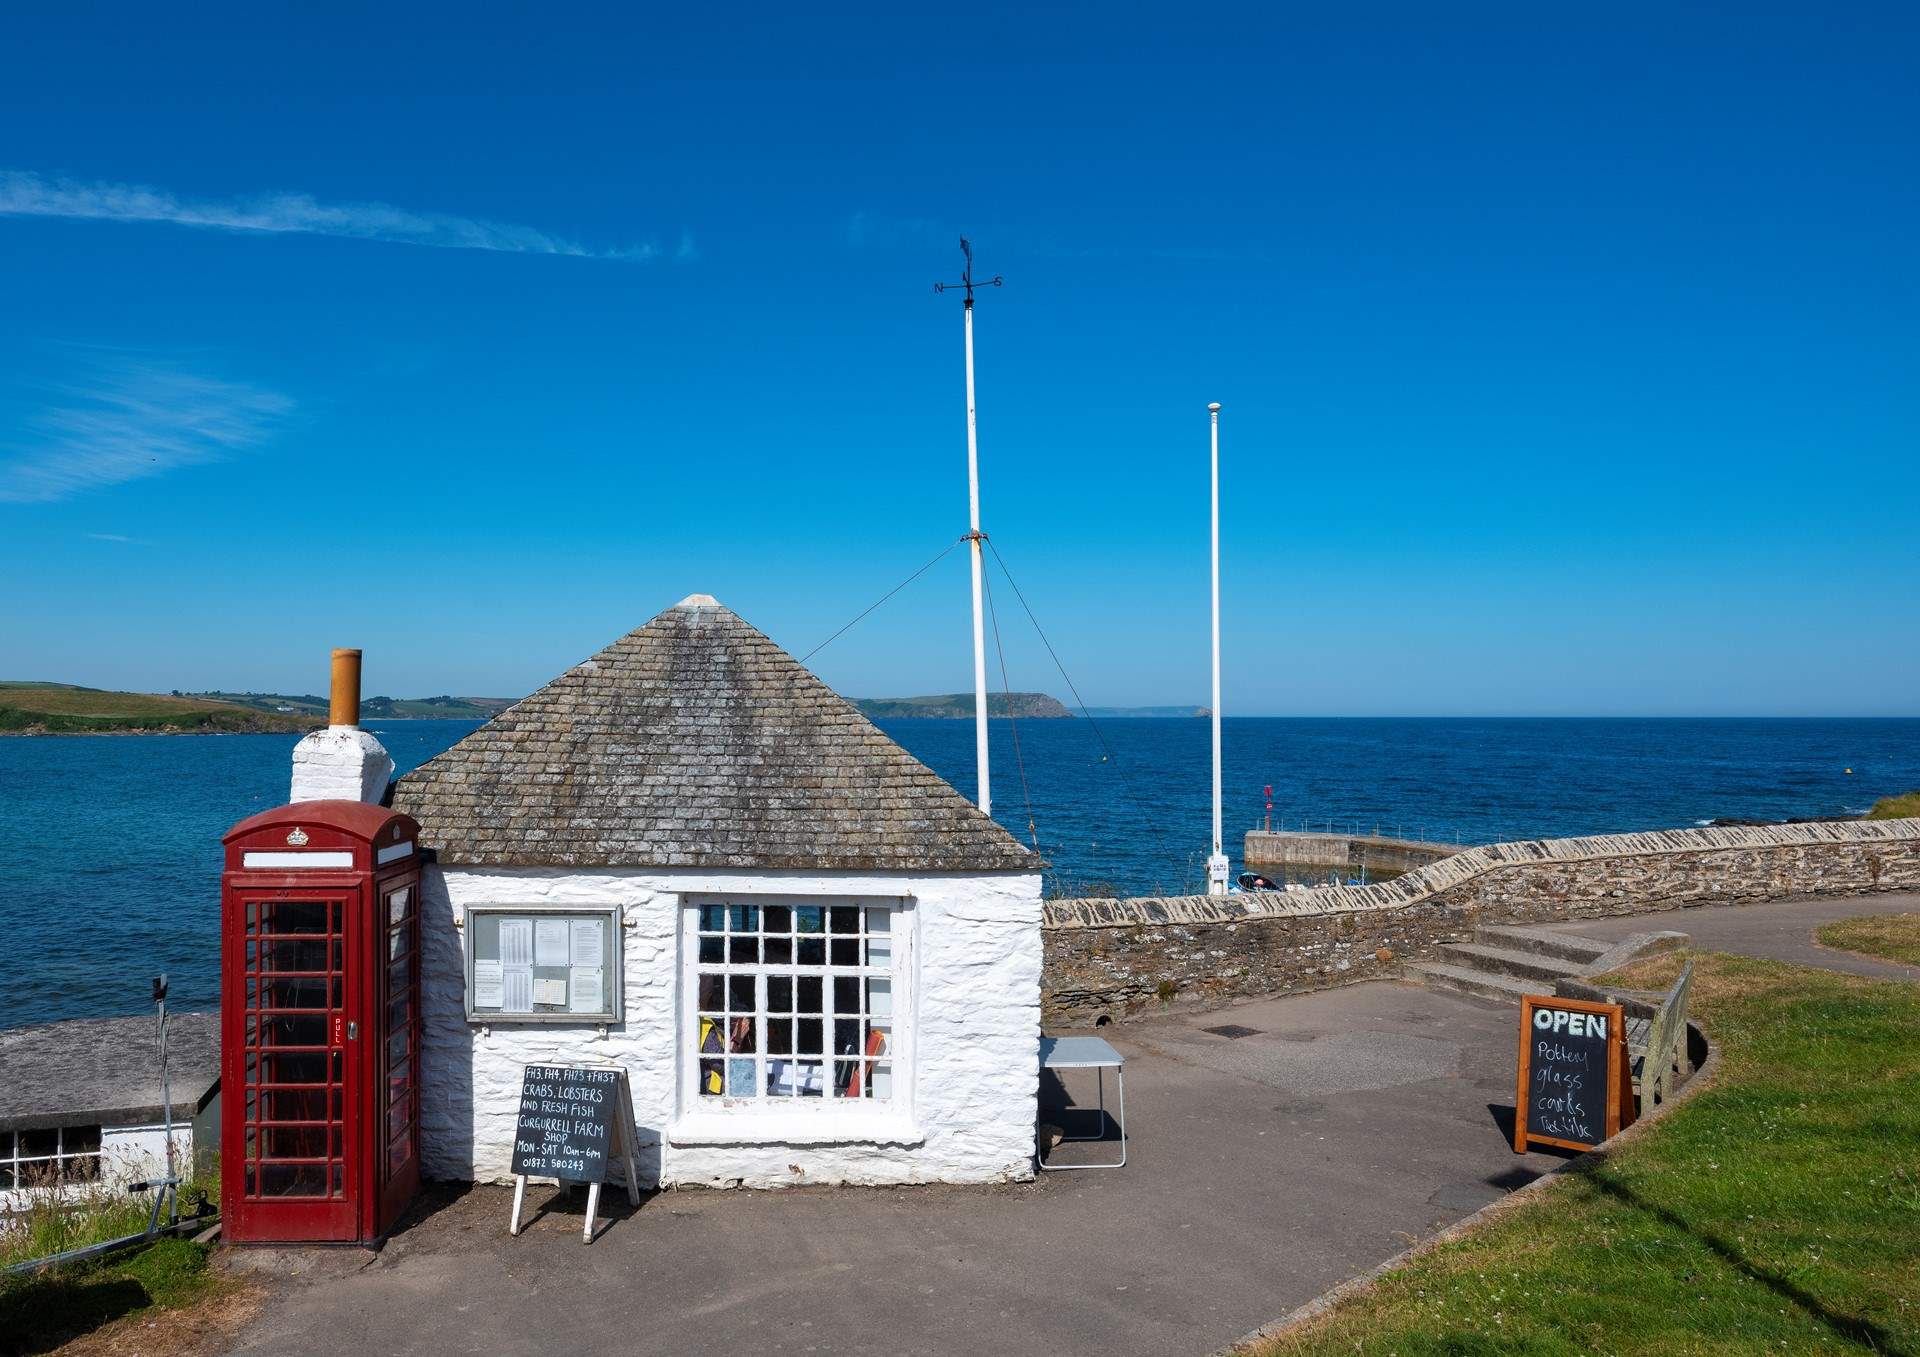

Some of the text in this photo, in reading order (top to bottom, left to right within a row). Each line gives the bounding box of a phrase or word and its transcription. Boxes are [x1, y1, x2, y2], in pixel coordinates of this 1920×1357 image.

[934, 282, 944, 293] N
[1534, 1009, 1606, 1040] OPEN
[563, 1069, 585, 1081] FH23
[558, 1086, 603, 1103] LOBSTERS
[521, 1100, 595, 1118] AND FRESH FISH
[574, 1120, 604, 1138] FARM
[544, 1131, 568, 1145] SHOP
[522, 1158, 546, 1168] 01872
